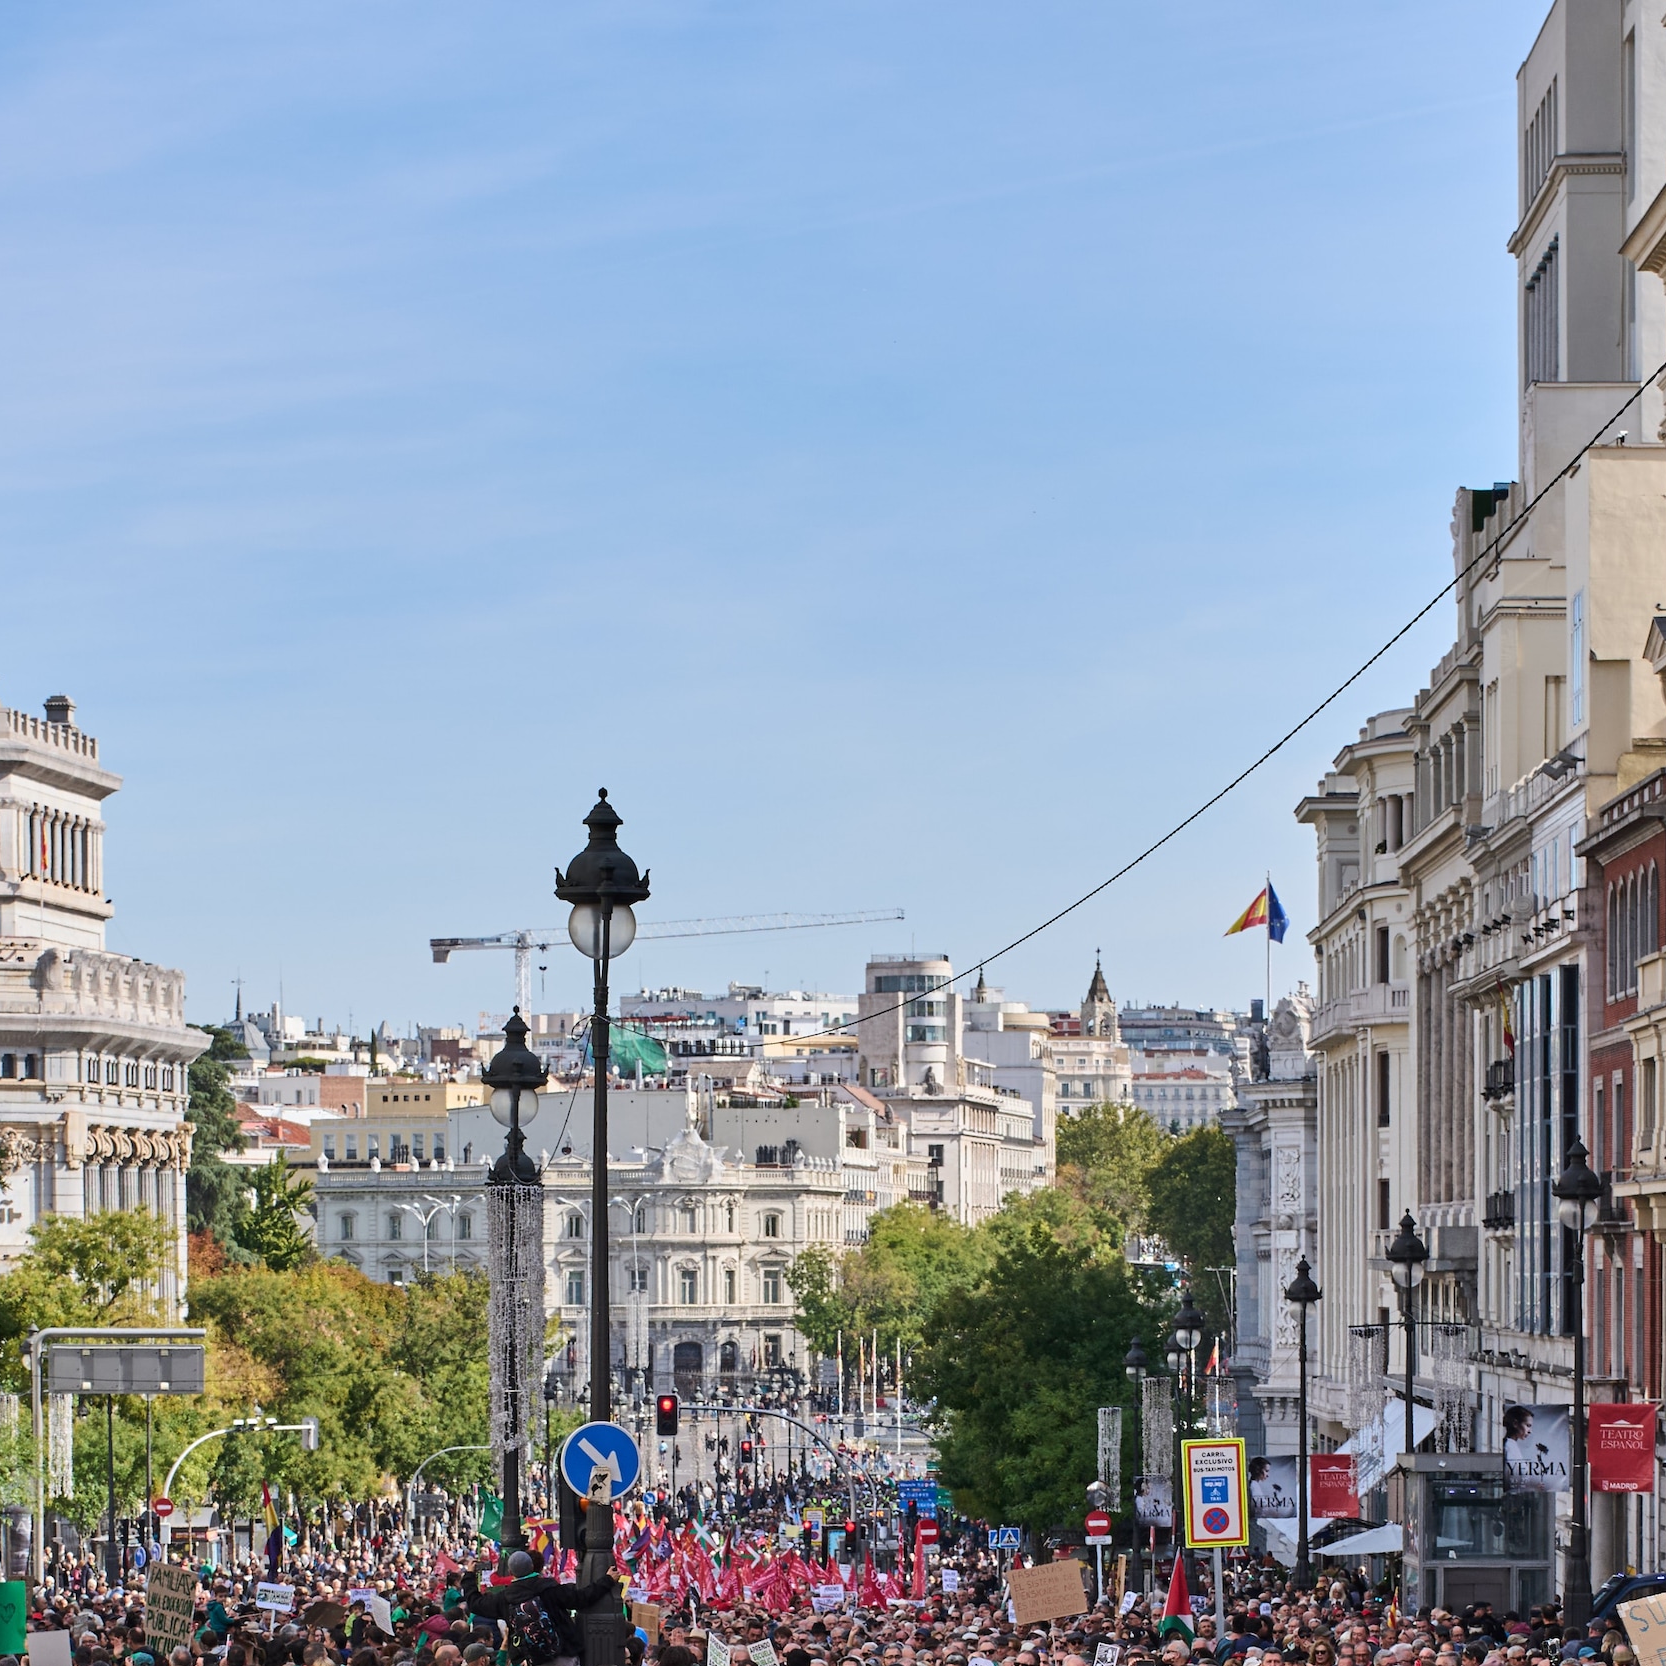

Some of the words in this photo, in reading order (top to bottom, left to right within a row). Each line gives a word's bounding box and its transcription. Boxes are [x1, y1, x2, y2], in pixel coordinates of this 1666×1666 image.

[1600, 1430, 1643, 1441] TEATRO
[1600, 1439, 1649, 1451] ESPAÑOL
[1507, 1461, 1566, 1476] YERMA
[1609, 1482, 1638, 1491] MADRID
[1250, 1497, 1295, 1508] YERMA
